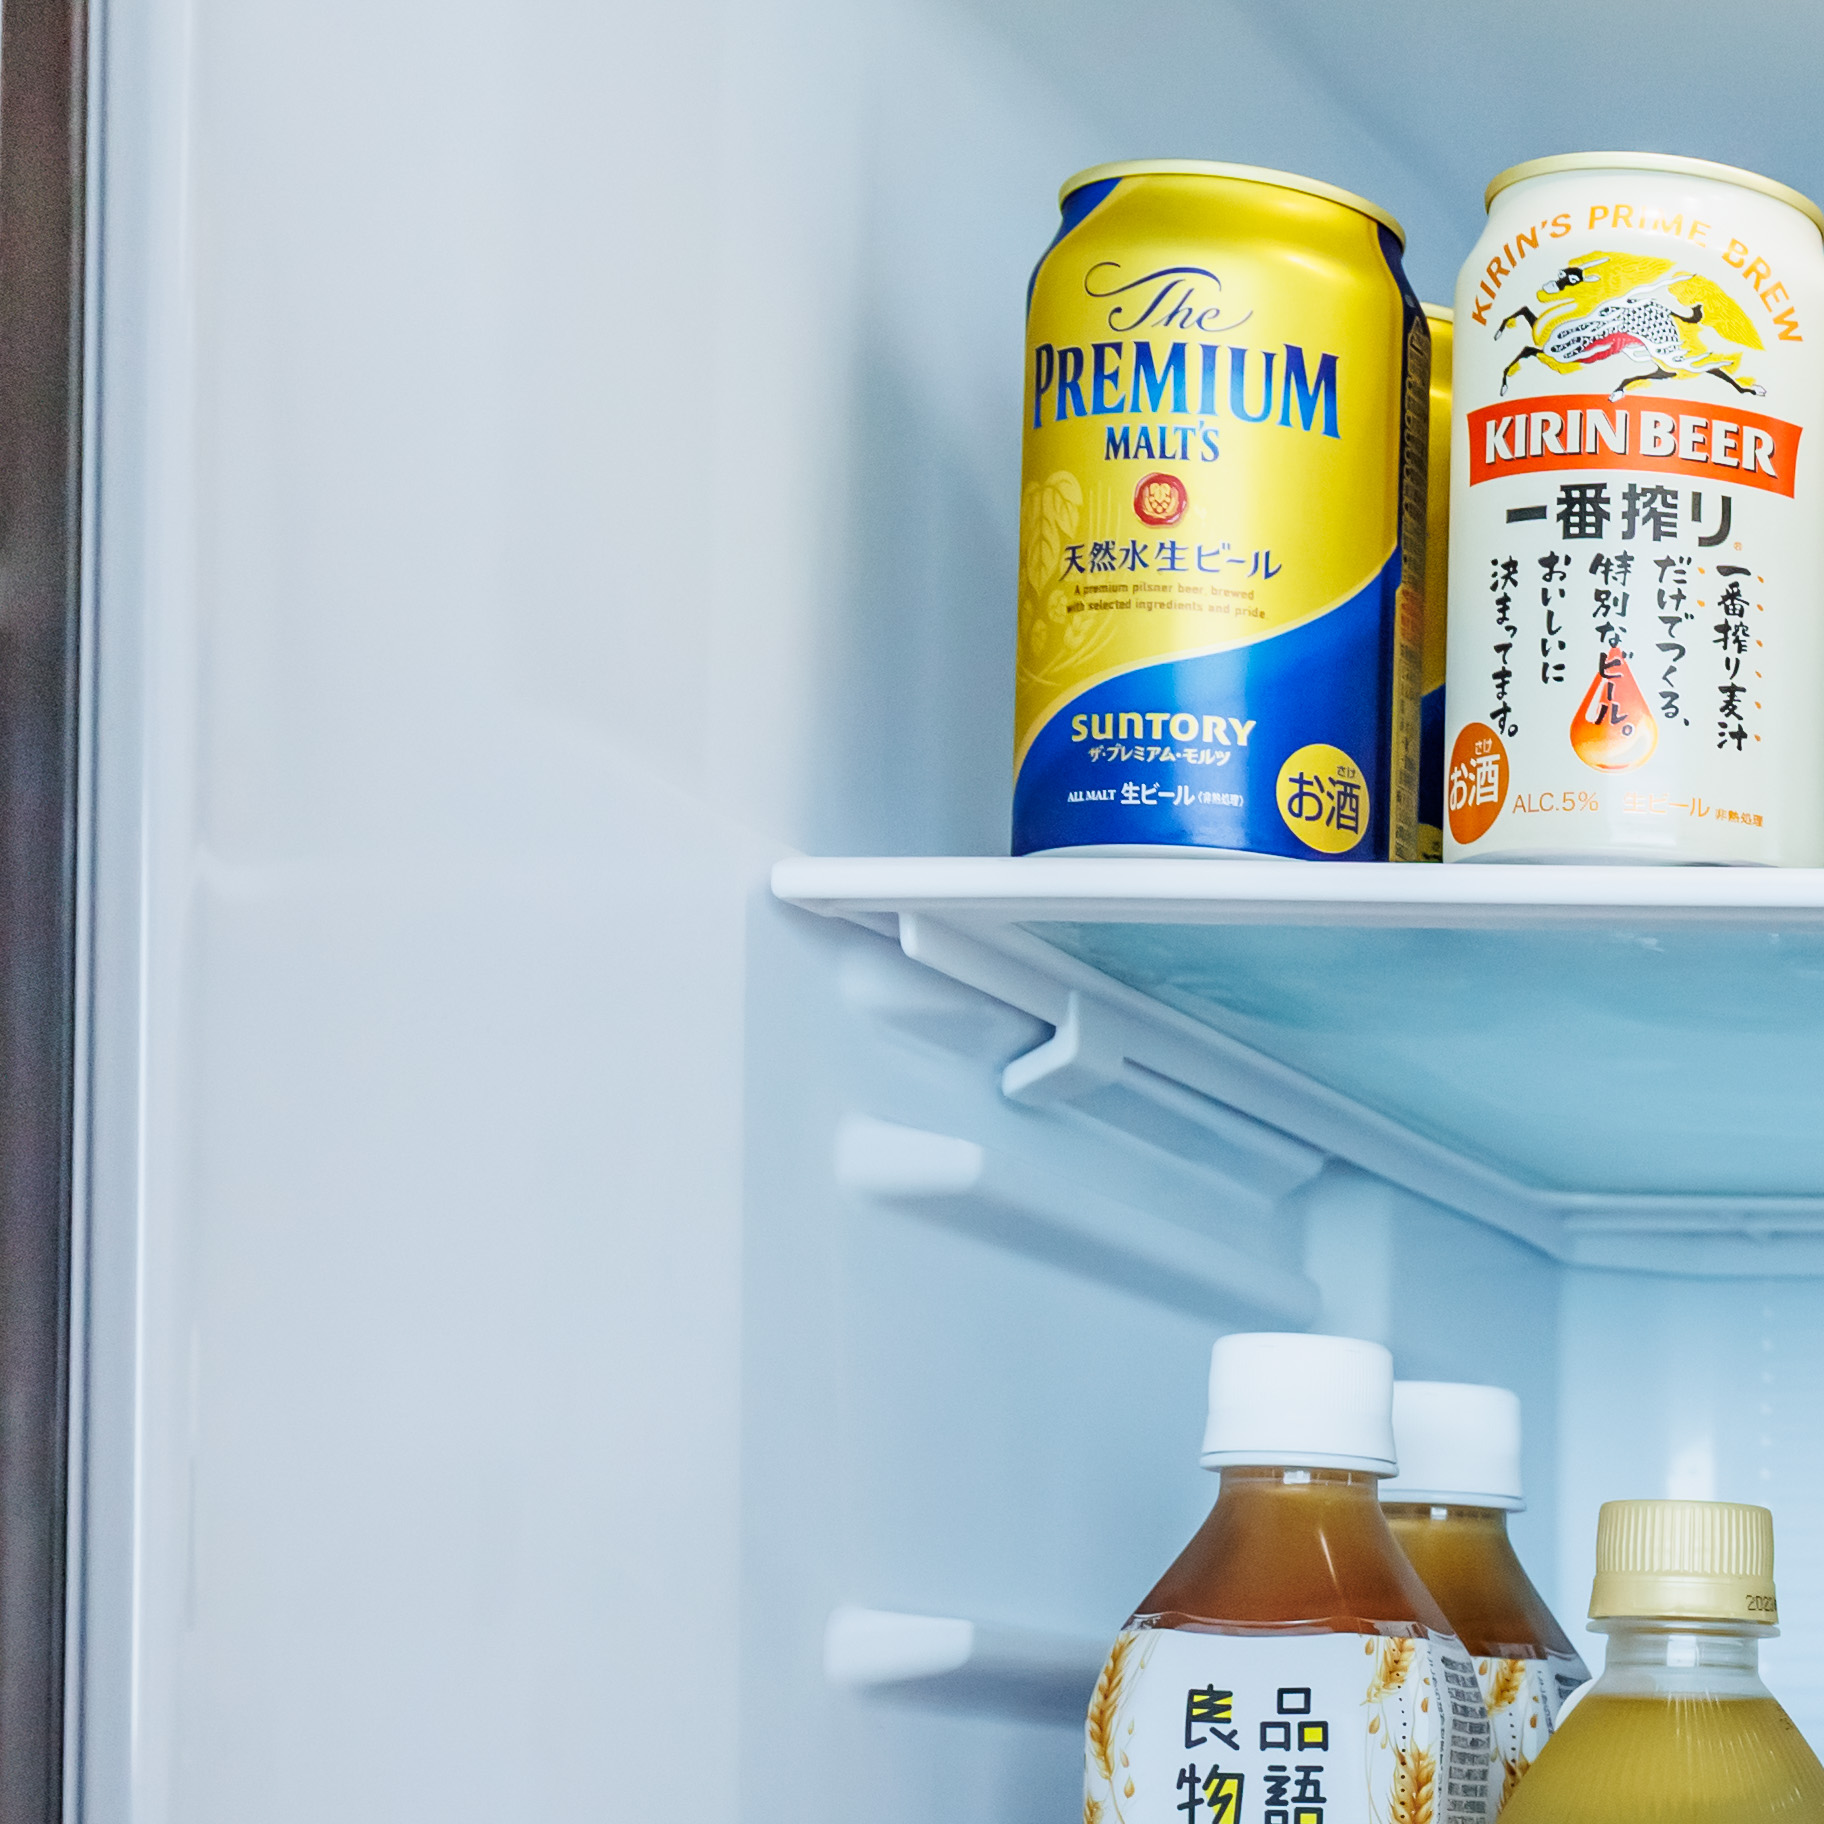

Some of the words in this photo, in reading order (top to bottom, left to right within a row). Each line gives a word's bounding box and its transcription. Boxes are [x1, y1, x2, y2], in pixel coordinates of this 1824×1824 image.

[1084, 261, 1254, 332] The
[1471, 213, 1572, 327] KIRIN'S
[1588, 204, 1707, 248] PRIME
[1722, 237, 1803, 344] BREW
[1032, 341, 1342, 439] PREMIUM
[1104, 418, 1220, 462] MALT'S
[1484, 408, 1630, 465] KIRIN
[1641, 416, 1778, 478] BEER
[1506, 481, 1733, 546] 一番搾り
[1063, 539, 1282, 582] 天然水生ビール
[1538, 555, 1571, 683] おいしいに
[1714, 563, 1752, 750] 一番搾り麦汁
[1072, 712, 1256, 747] SUNTORY
[1287, 772, 1360, 834] お酒
[1450, 754, 1500, 810] お酒
[1512, 791, 1599, 814] ALC.5%
[1184, 1683, 1329, 1752] 良品
